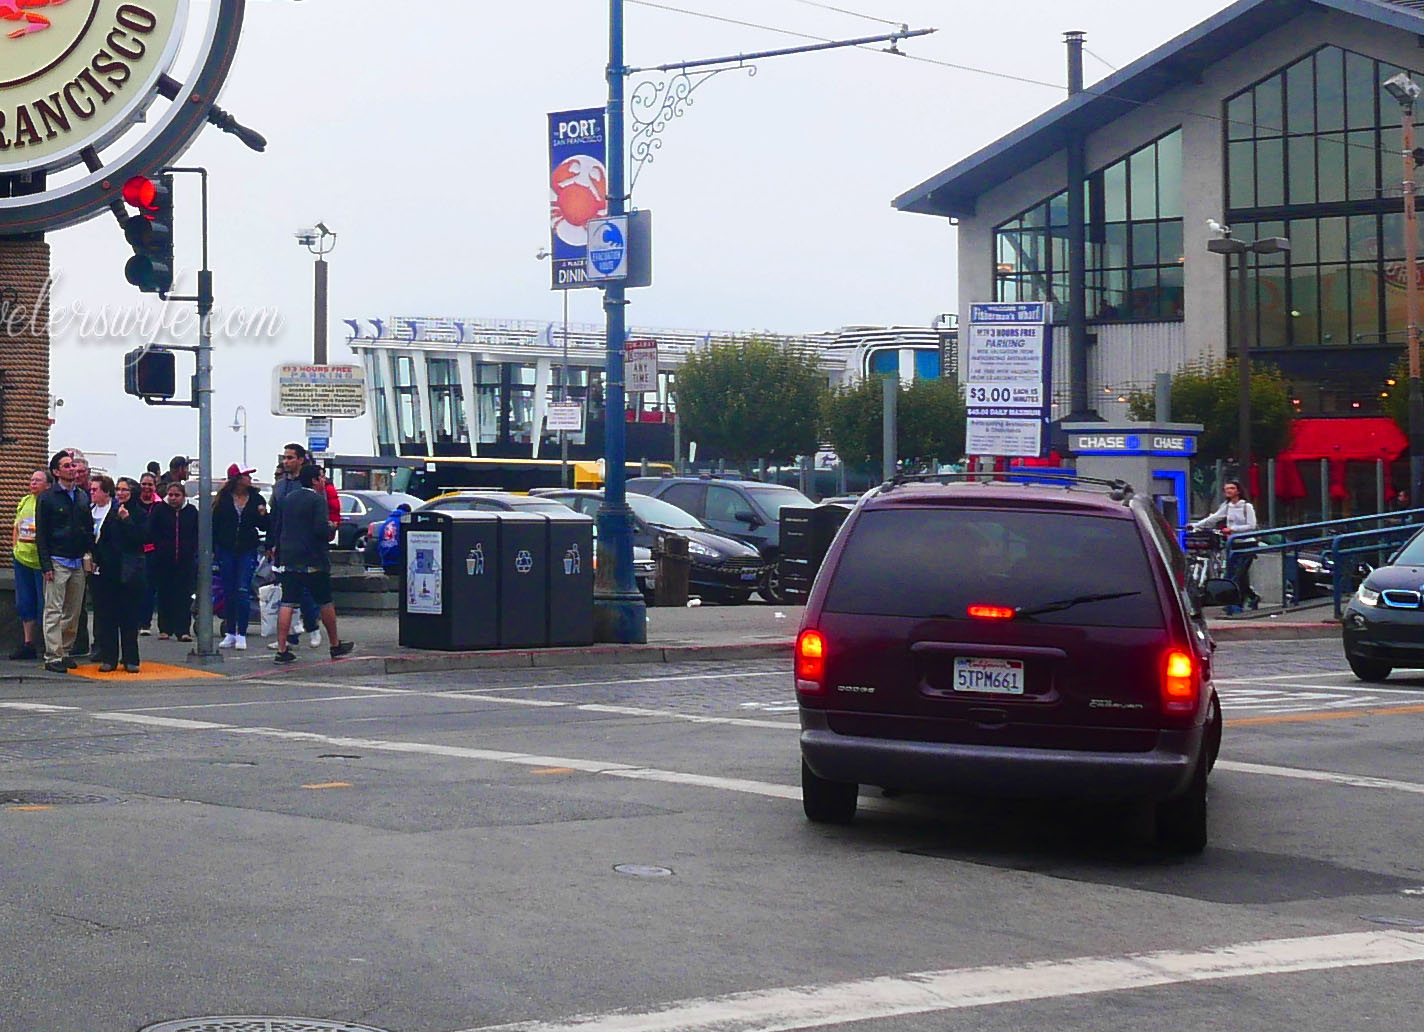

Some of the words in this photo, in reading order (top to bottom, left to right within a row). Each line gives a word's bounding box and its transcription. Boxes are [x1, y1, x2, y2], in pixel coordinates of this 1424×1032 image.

[559, 118, 596, 139] PORT
[567, 134, 603, 146] FRANCISCO
[558, 268, 588, 284] DININ
[996, 329, 1019, 337] HOURS
[1019, 329, 1036, 337] FREE
[986, 339, 1026, 348] PARKING
[632, 374, 649, 383] TIME
[970, 387, 1011, 402] $3.00
[989, 408, 1008, 416] DAILY
[1078, 436, 1125, 448] CHASE
[1153, 437, 1184, 449] CHASE
[958, 669, 1019, 690] 5TPM661
